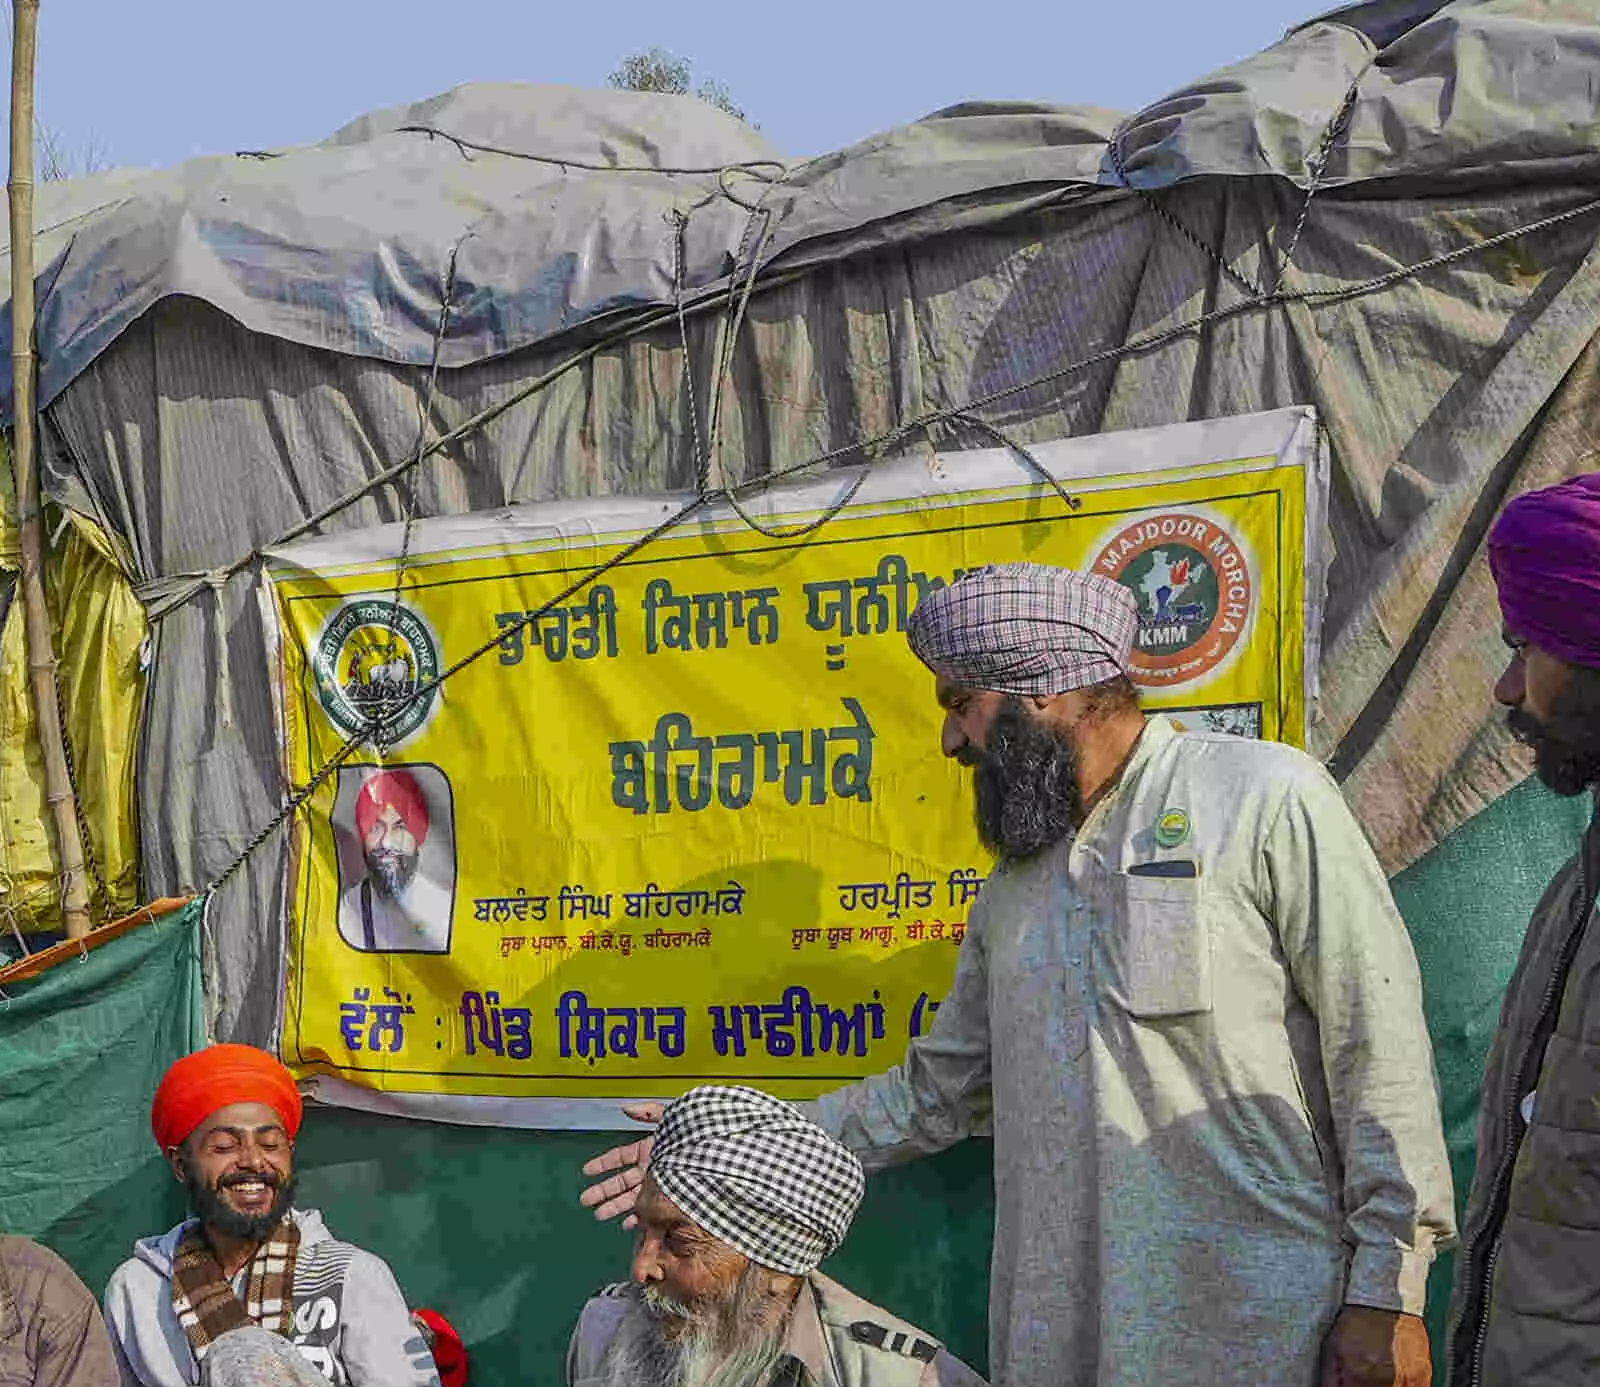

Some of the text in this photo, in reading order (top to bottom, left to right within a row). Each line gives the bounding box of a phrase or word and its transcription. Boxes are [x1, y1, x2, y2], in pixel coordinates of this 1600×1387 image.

[1101, 518, 1249, 634] MAJDOOR MORCHA
[494, 554, 988, 670] ਭਾਰਤੀ ਕਿਸਾਨ ਯੂਨੀ
[1139, 625, 1188, 648] KMM
[608, 697, 876, 815] ਬਹਿਰਾਮਕੇ
[473, 880, 746, 923] ਬਲਵੰਤ ਸਿੰਘ ਬਹਿਰਾਮਕੇ
[838, 867, 986, 919] ਹਰਪ੍ਰੀਤ ਸਿੰ
[644, 927, 713, 949] ਬਹਿਰਾਮਕੇ
[458, 990, 533, 1060] ਪਿੰਡ
[555, 990, 688, 1067] ਸ਼ਿਕਾਰ
[708, 986, 886, 1058] ਮਾਛੀਆਂ
